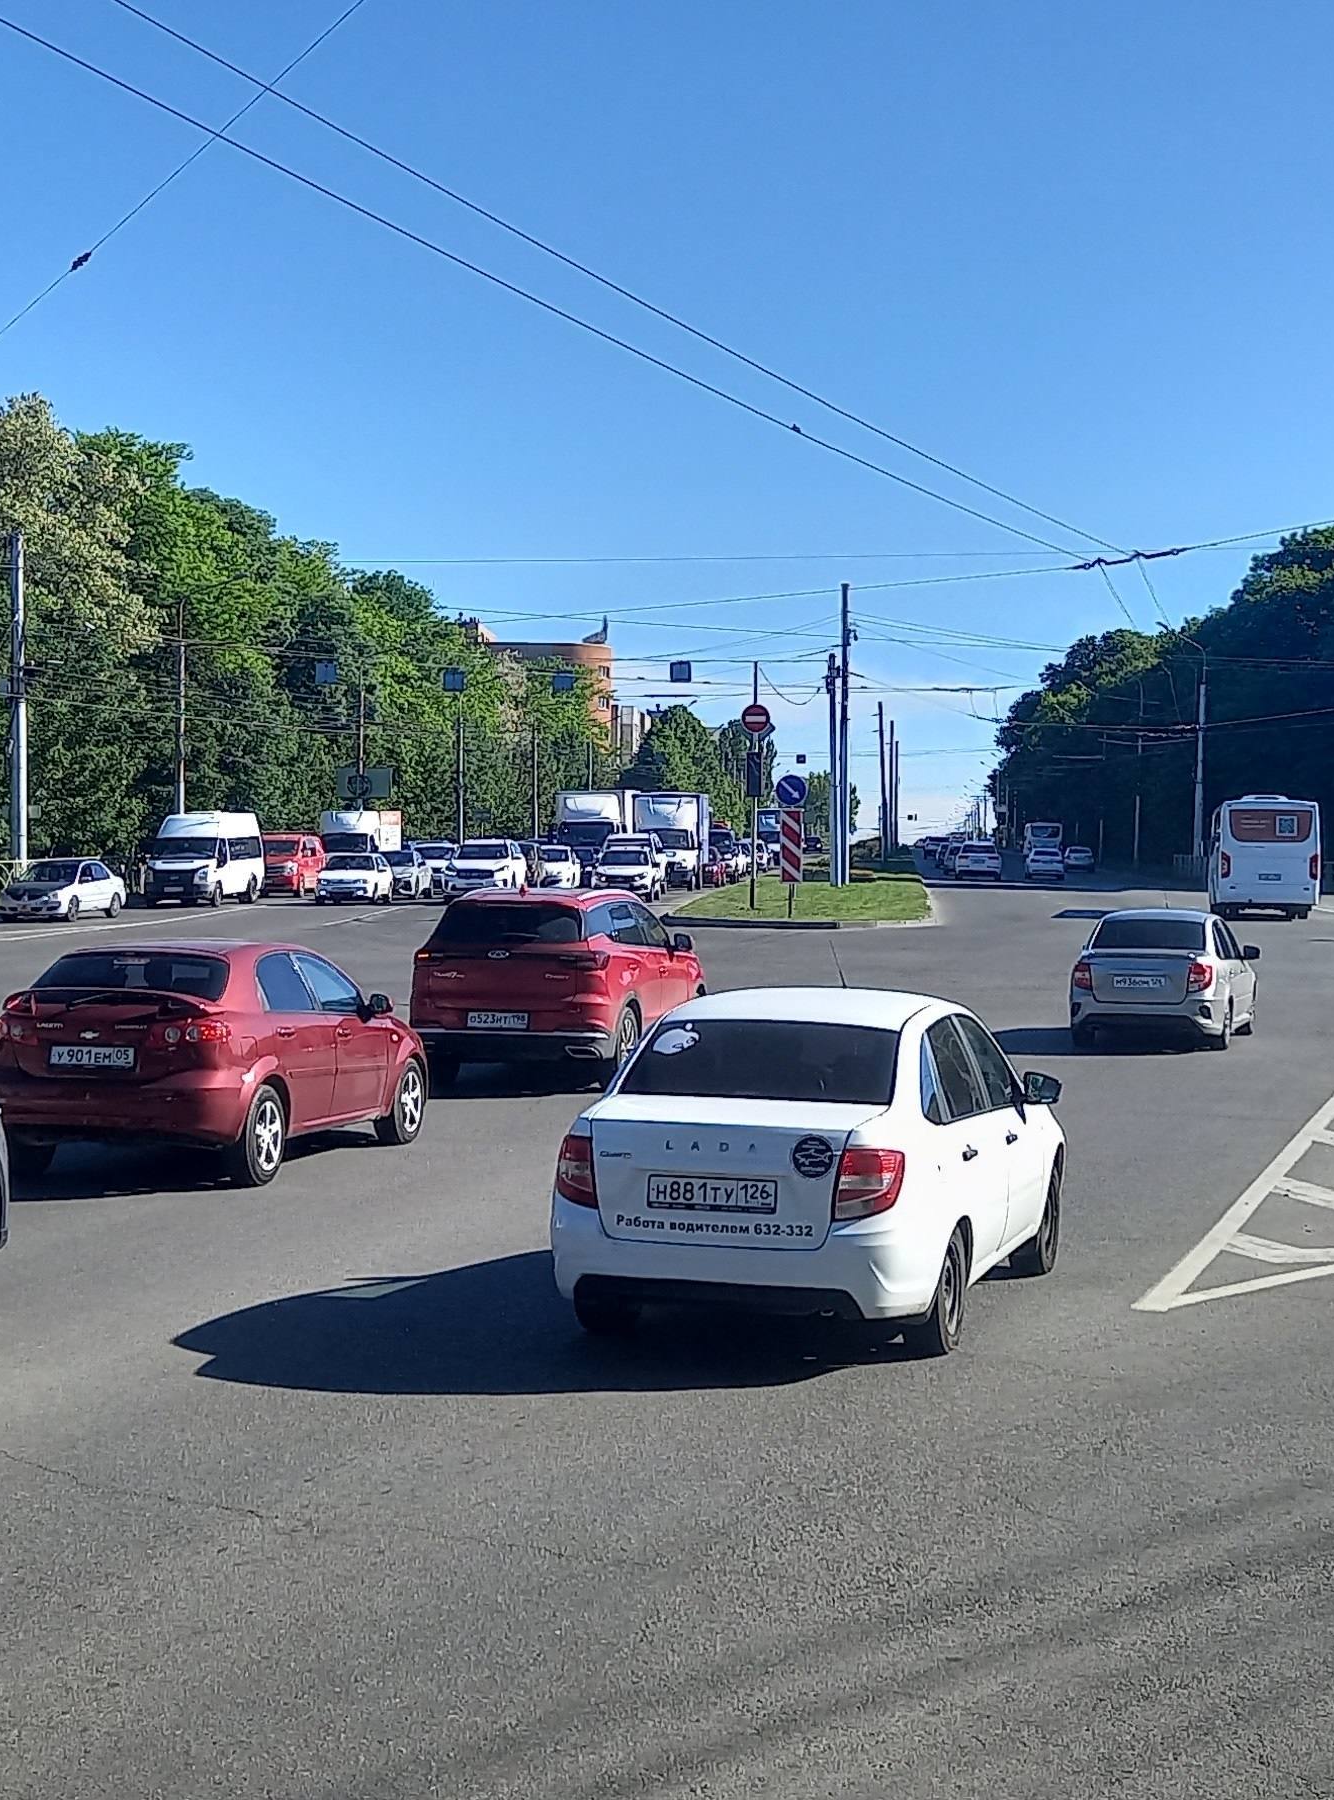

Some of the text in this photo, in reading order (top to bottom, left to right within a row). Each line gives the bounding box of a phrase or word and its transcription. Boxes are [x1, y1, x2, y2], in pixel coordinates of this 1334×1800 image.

[115, 1048, 130, 1061] 05
[665, 1139, 757, 1153] LADA
[656, 1180, 770, 1204] Н881ТУ 126
[616, 1214, 814, 1238] Работа водителем 632-332
